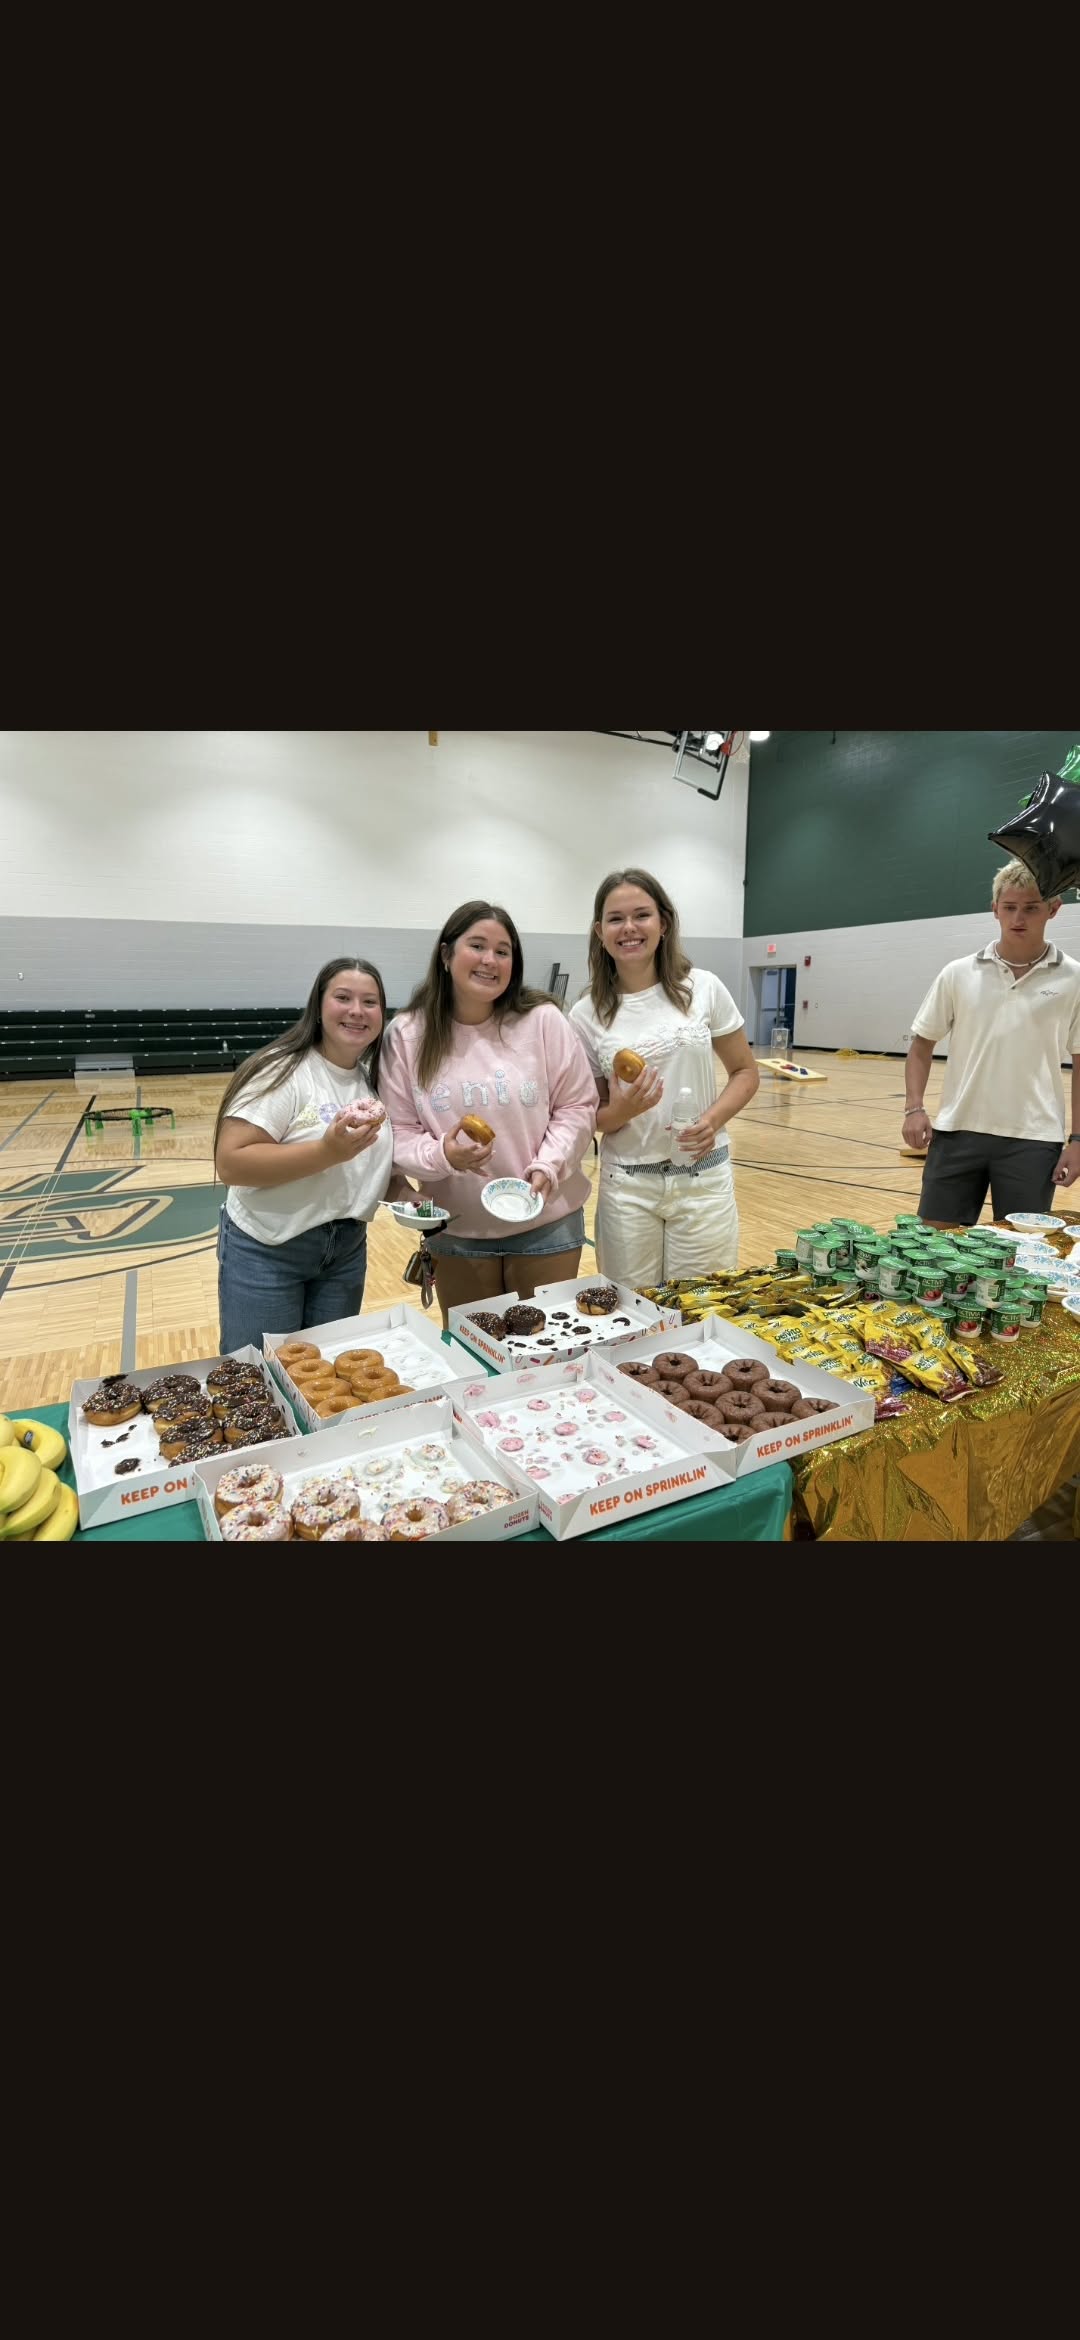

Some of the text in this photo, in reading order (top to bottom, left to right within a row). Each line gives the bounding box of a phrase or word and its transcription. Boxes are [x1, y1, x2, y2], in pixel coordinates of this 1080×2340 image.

[757, 1415, 853, 1458] KEEP ON SPRINKLIN'
[121, 1485, 160, 1505] KEEP
[163, 1477, 188, 1494] ON
[590, 1465, 707, 1516] KEEP ON SPRINKLIN'
[504, 1514, 529, 1529] DONUTS
[508, 1509, 529, 1521] DOZEN
